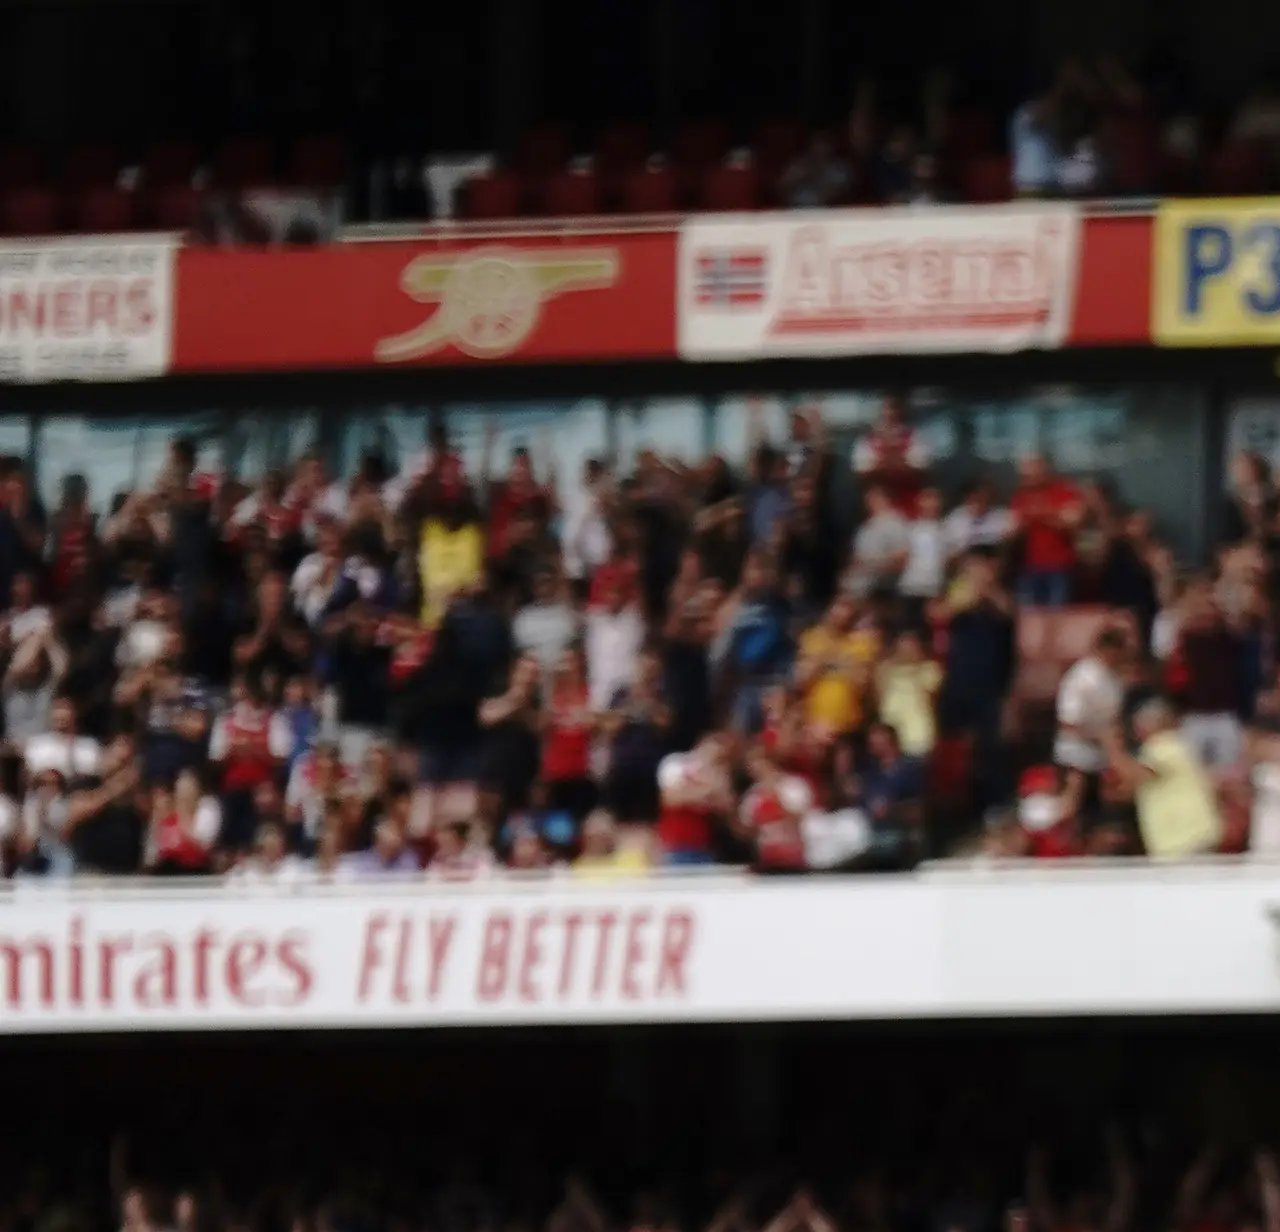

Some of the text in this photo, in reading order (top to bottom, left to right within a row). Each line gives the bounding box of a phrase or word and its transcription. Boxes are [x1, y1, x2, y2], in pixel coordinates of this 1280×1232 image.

[0, 276, 157, 339] NERS
[356, 908, 457, 1003] FLY
[475, 904, 699, 1001] BETTER
